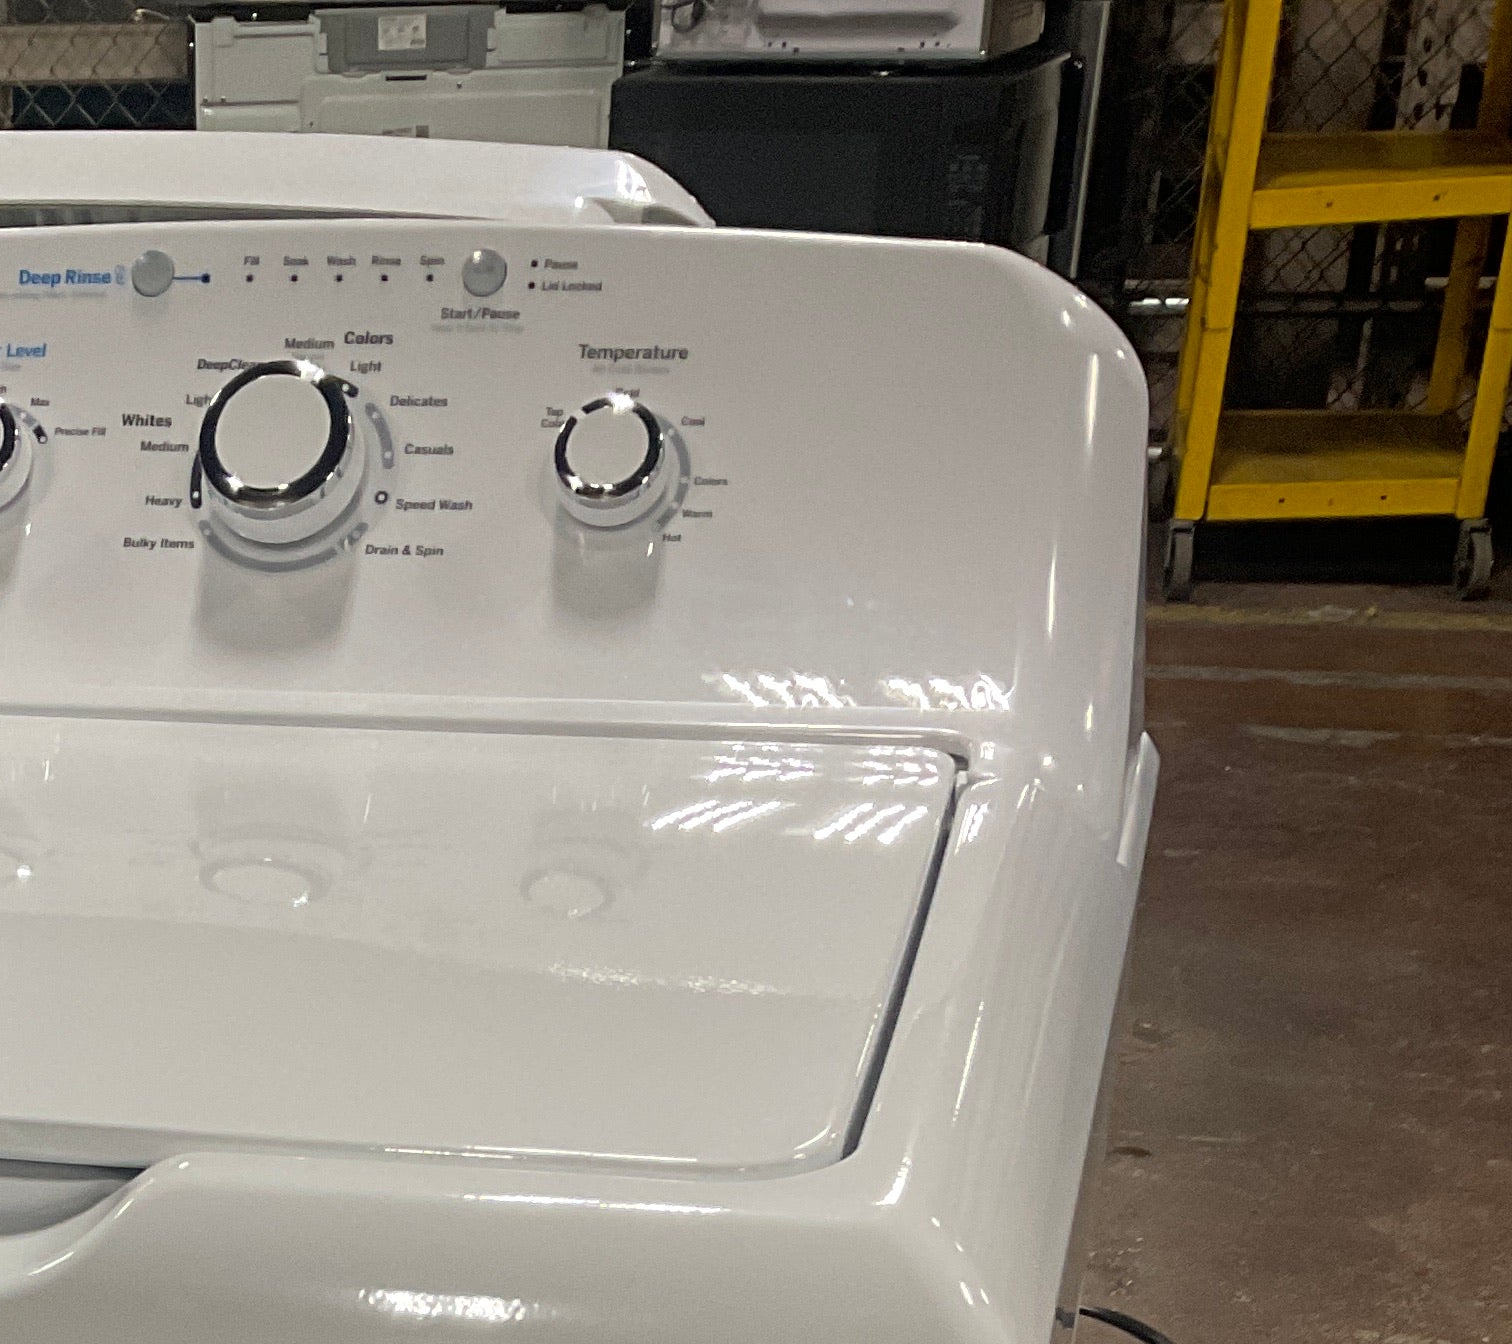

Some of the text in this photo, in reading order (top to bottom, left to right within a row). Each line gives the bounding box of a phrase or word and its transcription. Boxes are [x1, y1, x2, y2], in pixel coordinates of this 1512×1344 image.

[244, 255, 260, 266] Fill
[327, 256, 356, 266] Wash
[371, 255, 401, 266] Rinse
[544, 258, 578, 270] Pause
[19, 269, 112, 287] Deep Rinse
[440, 307, 520, 320] Start/Pause
[284, 338, 335, 350] Medium
[344, 331, 394, 345] Colors
[6, 343, 47, 357] Level
[579, 344, 688, 362] Temperature
[350, 360, 382, 374] Light
[390, 395, 449, 407] Delicates
[122, 413, 173, 428] Whites
[140, 440, 190, 453] Medium
[404, 443, 455, 456] Casuals
[145, 495, 184, 509] Heavy
[395, 498, 474, 512] Speed Wash
[123, 536, 195, 551] Bulky Items
[662, 533, 681, 543] Hot
[365, 544, 445, 558] Drain & Spin
